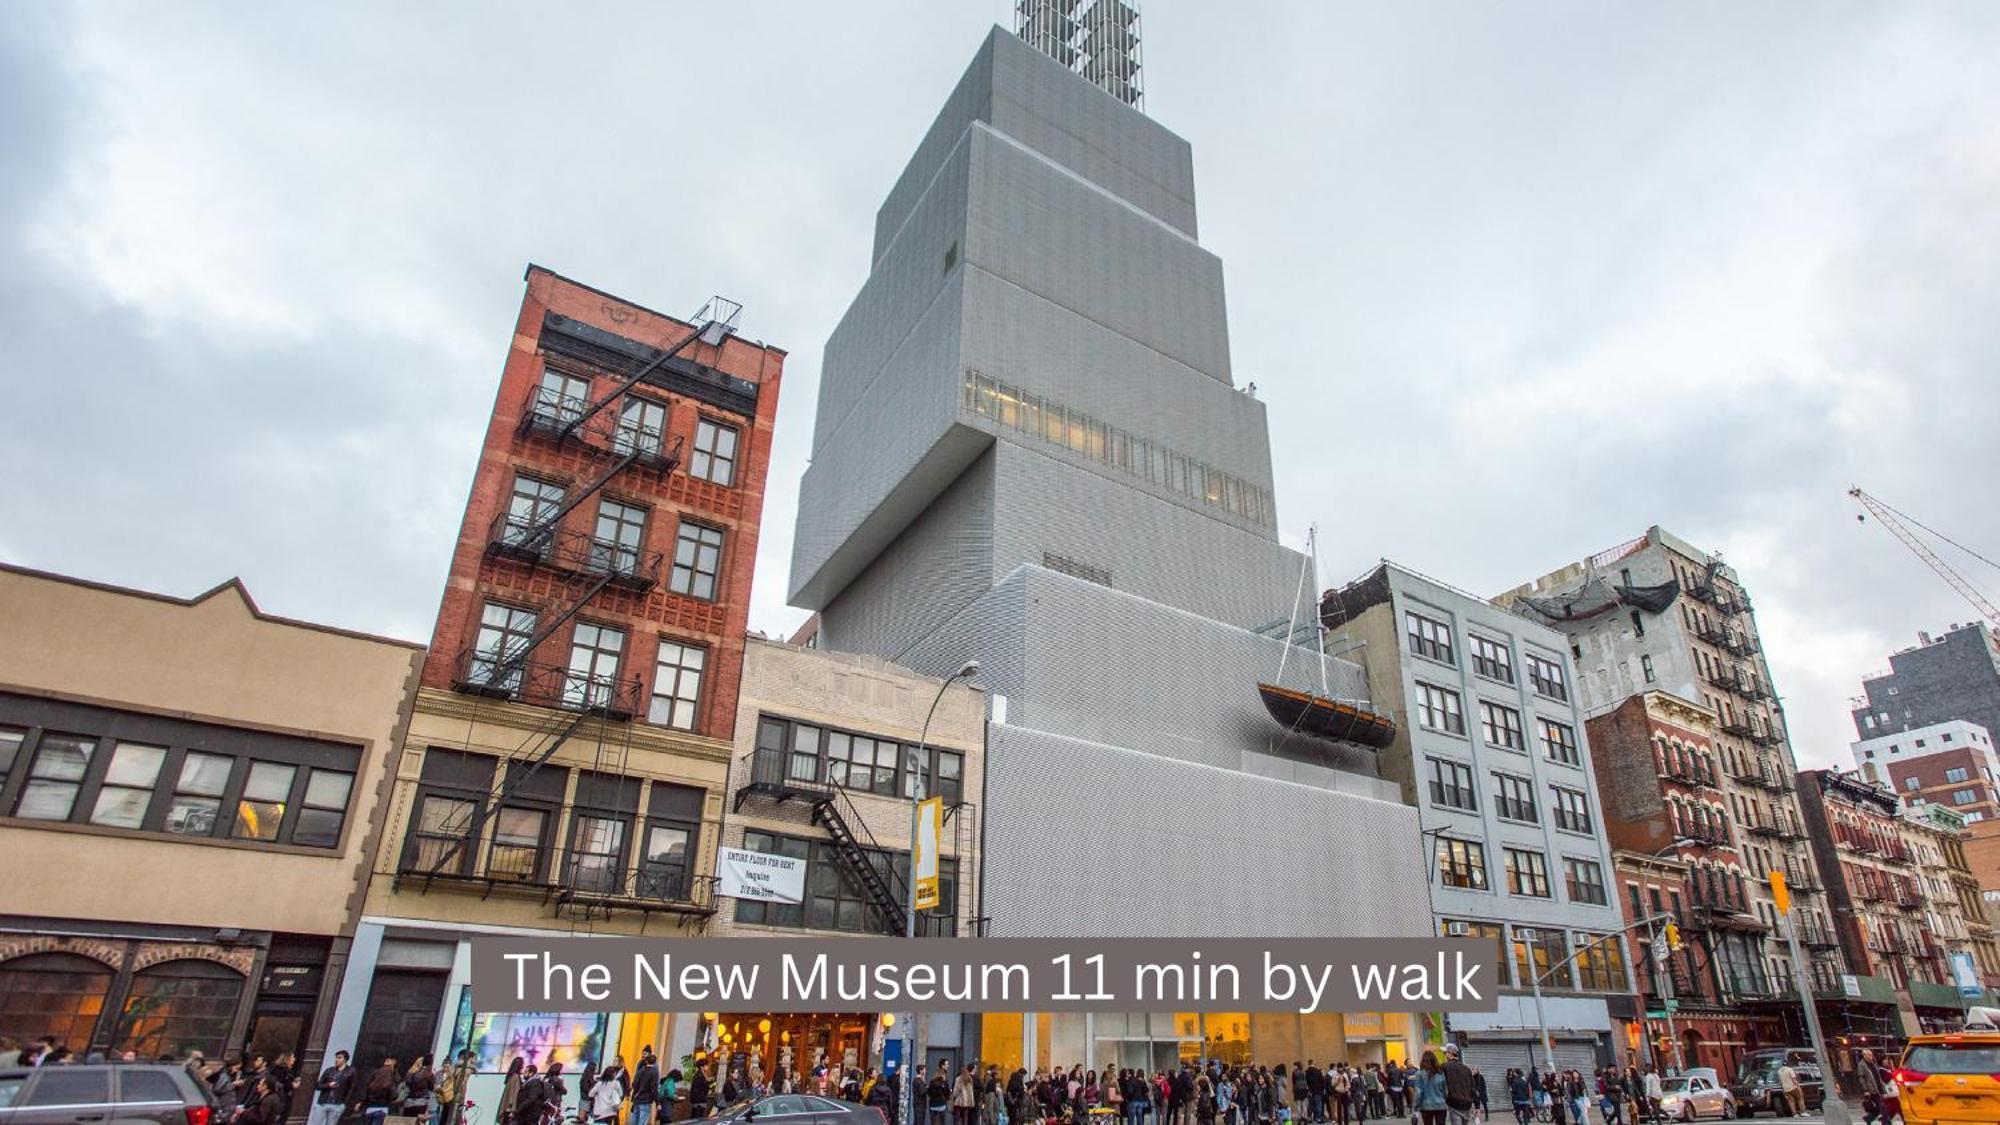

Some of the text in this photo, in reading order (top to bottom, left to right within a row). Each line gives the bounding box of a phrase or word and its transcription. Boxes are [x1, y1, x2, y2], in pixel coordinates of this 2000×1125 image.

[728, 851, 795, 870] ENTIRE FLOOR FOR RENT
